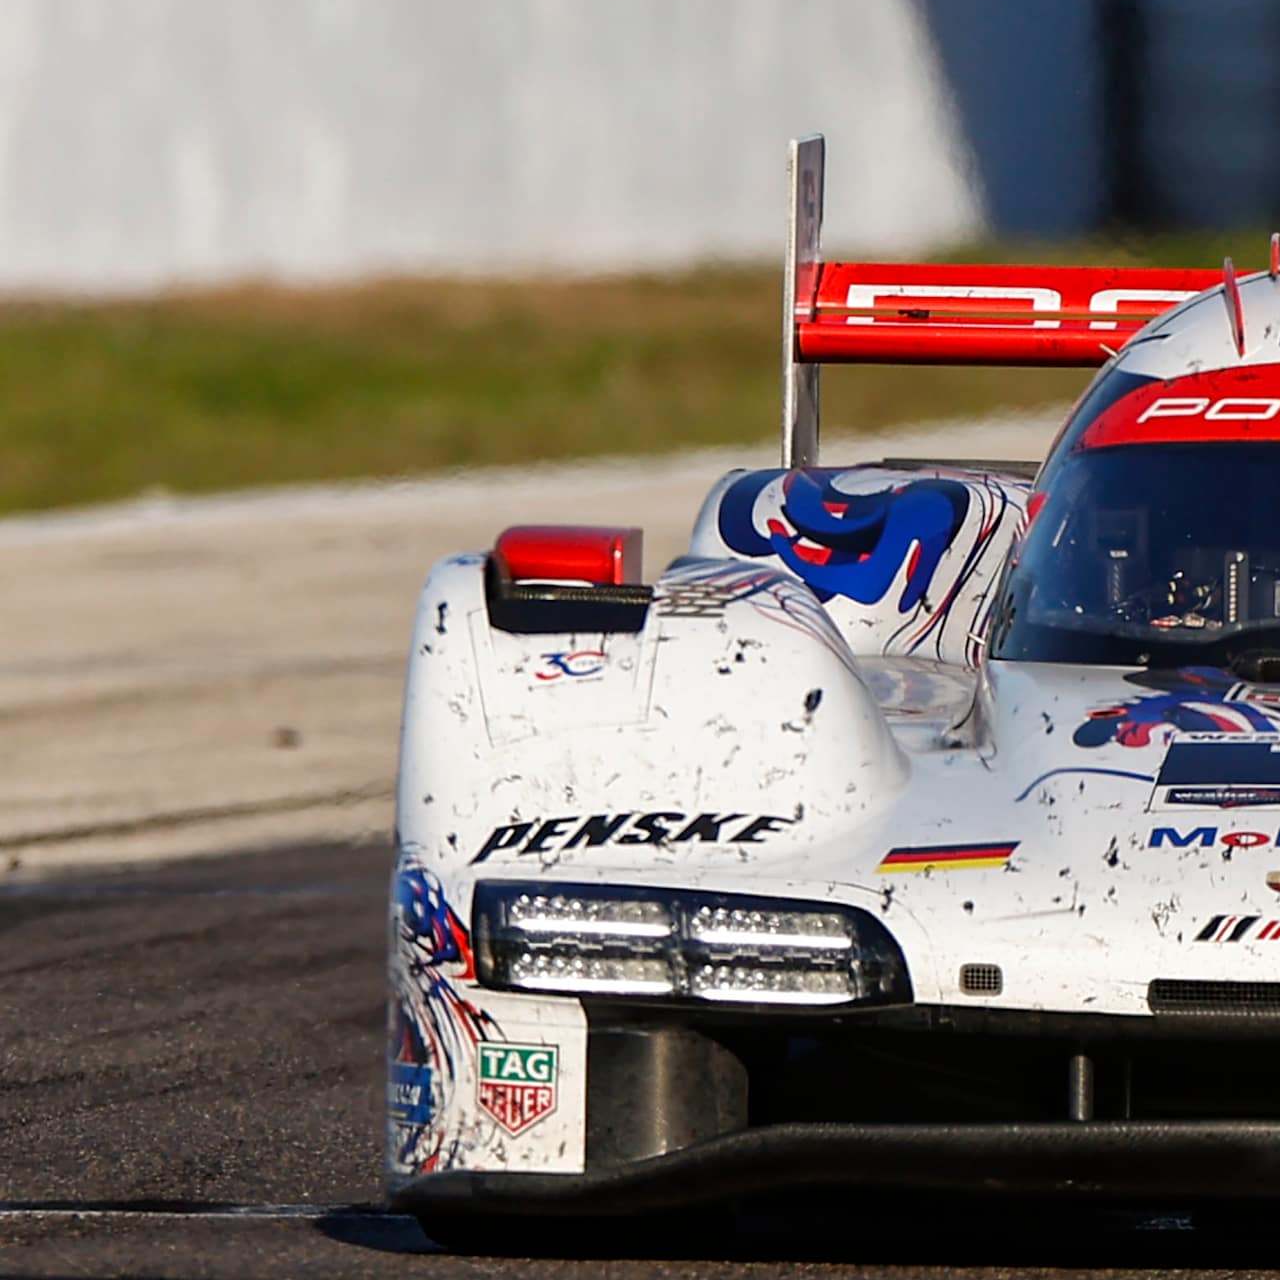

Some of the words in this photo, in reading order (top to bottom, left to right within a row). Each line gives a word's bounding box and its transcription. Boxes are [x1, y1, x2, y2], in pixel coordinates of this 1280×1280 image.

[467, 812, 798, 866] PENSKE
[482, 1050, 551, 1081] TAG
[480, 1085, 551, 1128] HEUER
